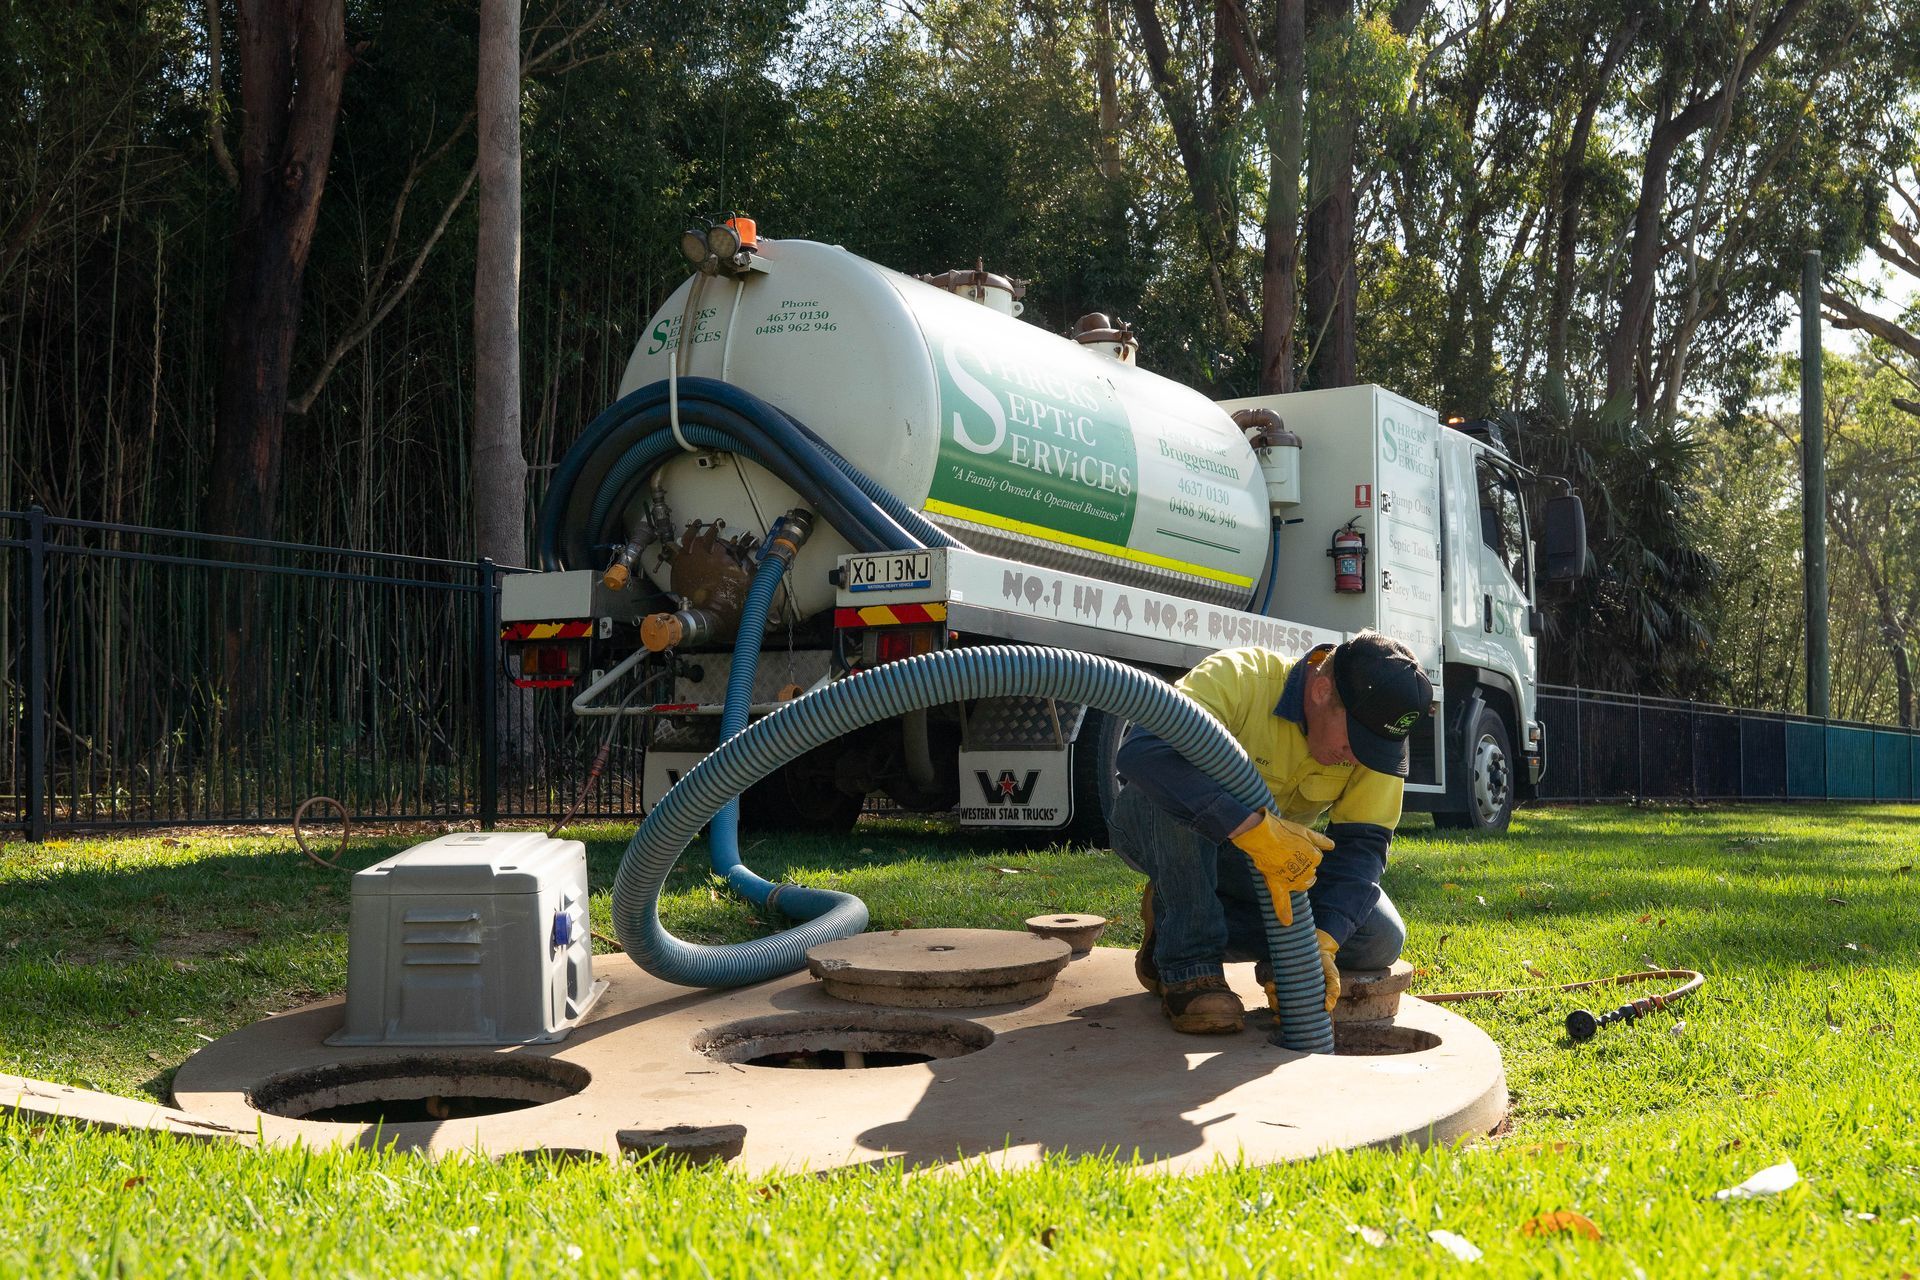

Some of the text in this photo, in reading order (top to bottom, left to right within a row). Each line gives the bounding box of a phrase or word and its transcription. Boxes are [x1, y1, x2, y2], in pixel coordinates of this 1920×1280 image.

[767, 310, 829, 322] 4637 0130
[781, 300, 819, 308] Phone
[755, 322, 837, 335] 0488 962 946
[1158, 438, 1240, 480] Bruggemann
[966, 470, 998, 492] Family
[1000, 479, 1031, 499] Owned
[1033, 487, 1042, 501] &
[1044, 492, 1083, 512] Operated
[1177, 477, 1229, 506] 4637 0130
[1391, 490, 1432, 517] Pump Outs
[1169, 496, 1237, 530] 0488 962 946
[1389, 534, 1434, 561] Septic Tanks
[1393, 580, 1431, 602] Grey Water
[1003, 569, 1314, 656] NO.1 IN A NO.2 BUSINESS
[1390, 624, 1414, 642] Grease
[961, 807, 996, 820] WESTERN
[999, 807, 1019, 820] STAR
